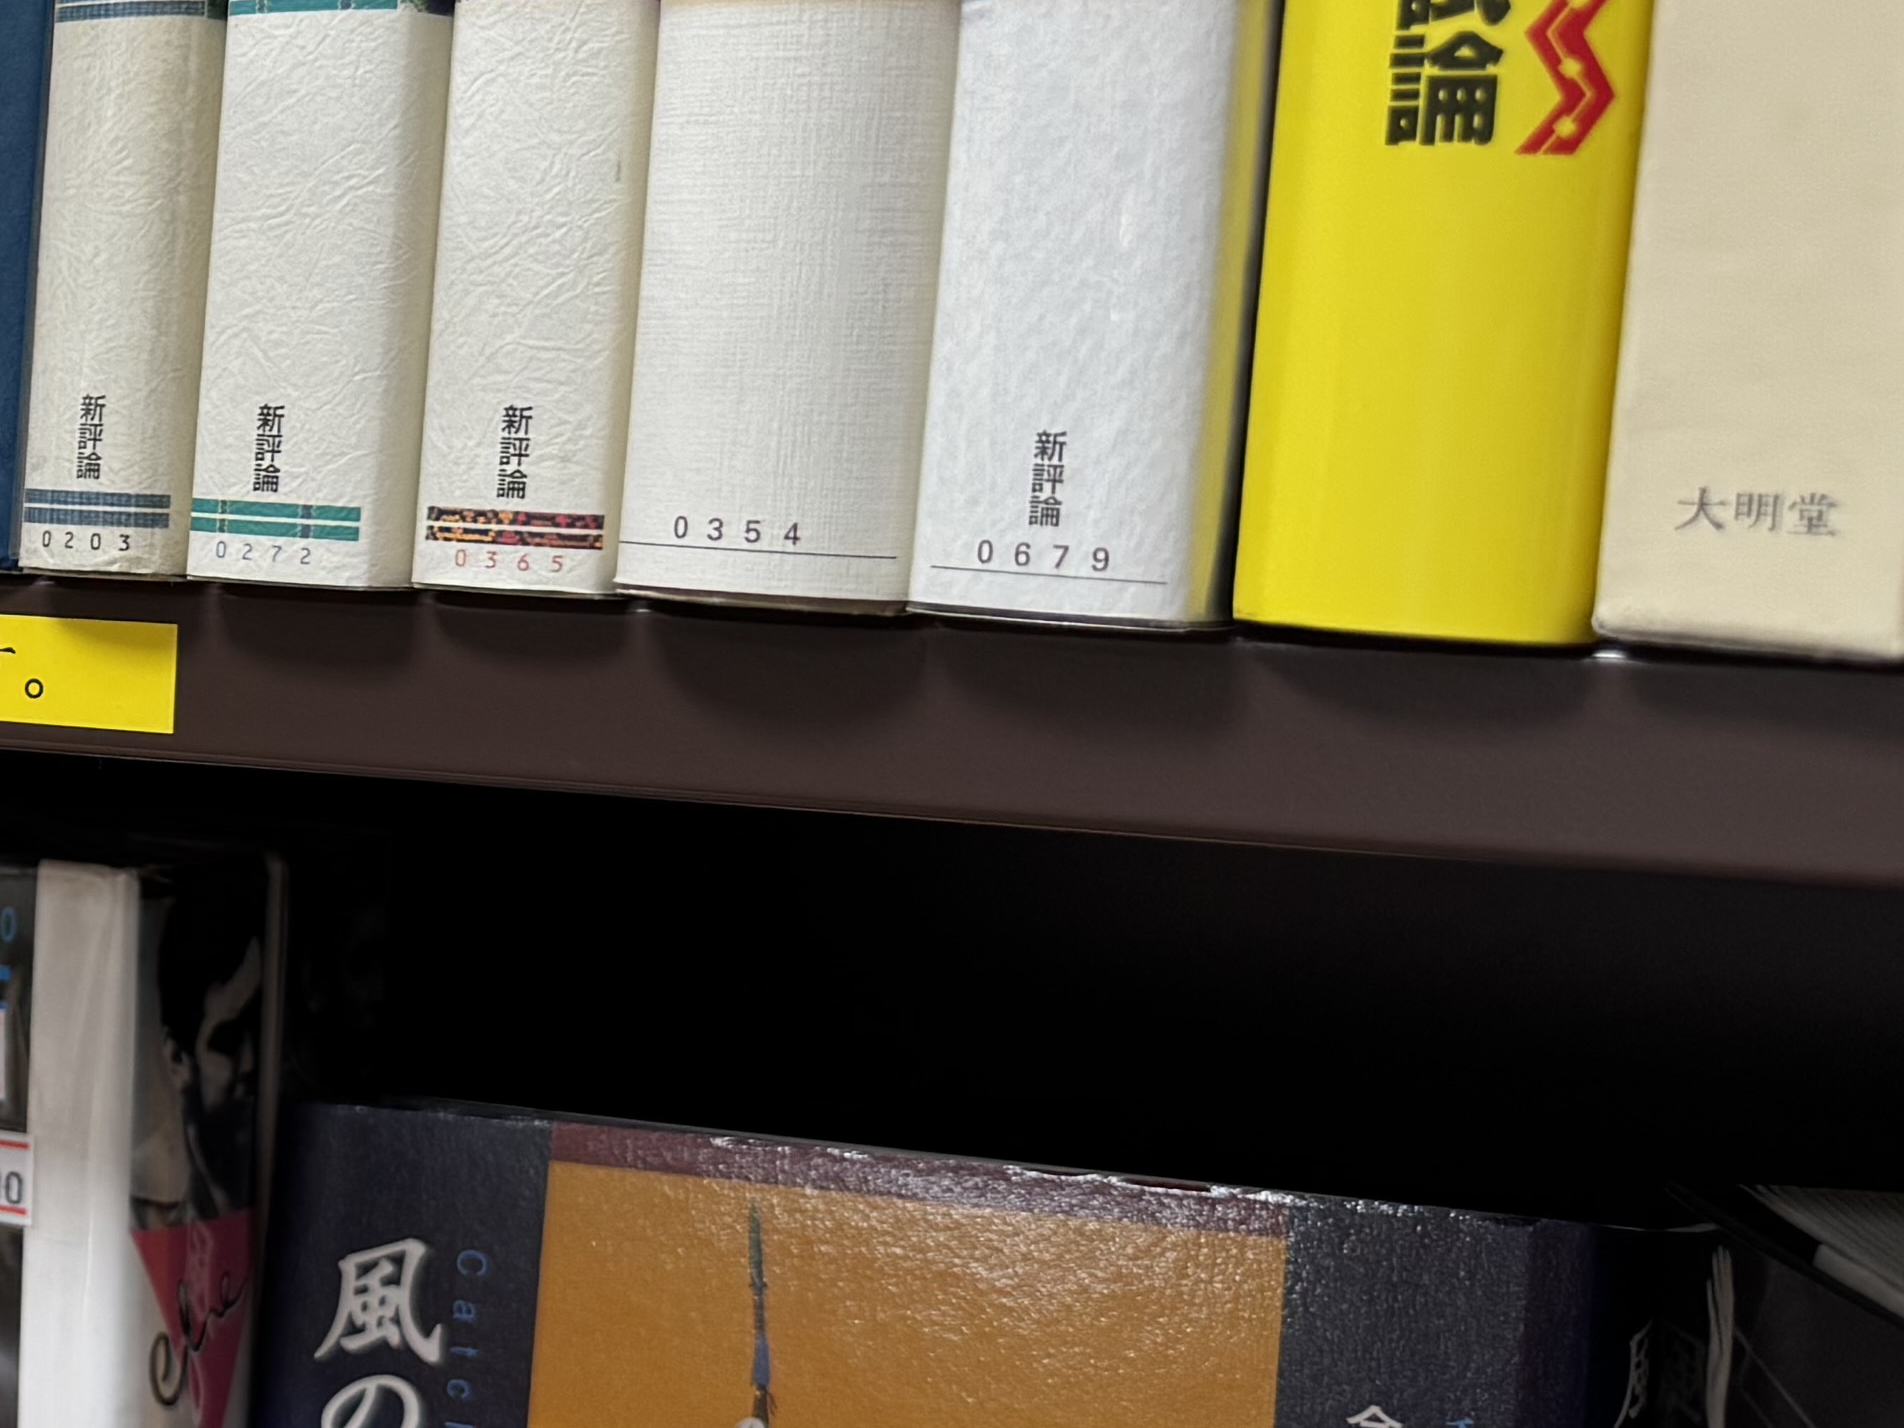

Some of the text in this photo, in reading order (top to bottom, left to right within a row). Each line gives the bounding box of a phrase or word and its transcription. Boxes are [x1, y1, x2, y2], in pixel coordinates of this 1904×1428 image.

[74, 392, 109, 484] 新評論
[250, 402, 289, 497] 新評論
[494, 402, 536, 502] 新評論
[1027, 428, 1071, 529] 新評論
[671, 514, 805, 550] 0354
[1674, 485, 1841, 539] 大明堂
[39, 527, 133, 554] 0203
[214, 537, 313, 567] 0272
[452, 545, 567, 576] 0365
[974, 540, 1112, 573] 0679
